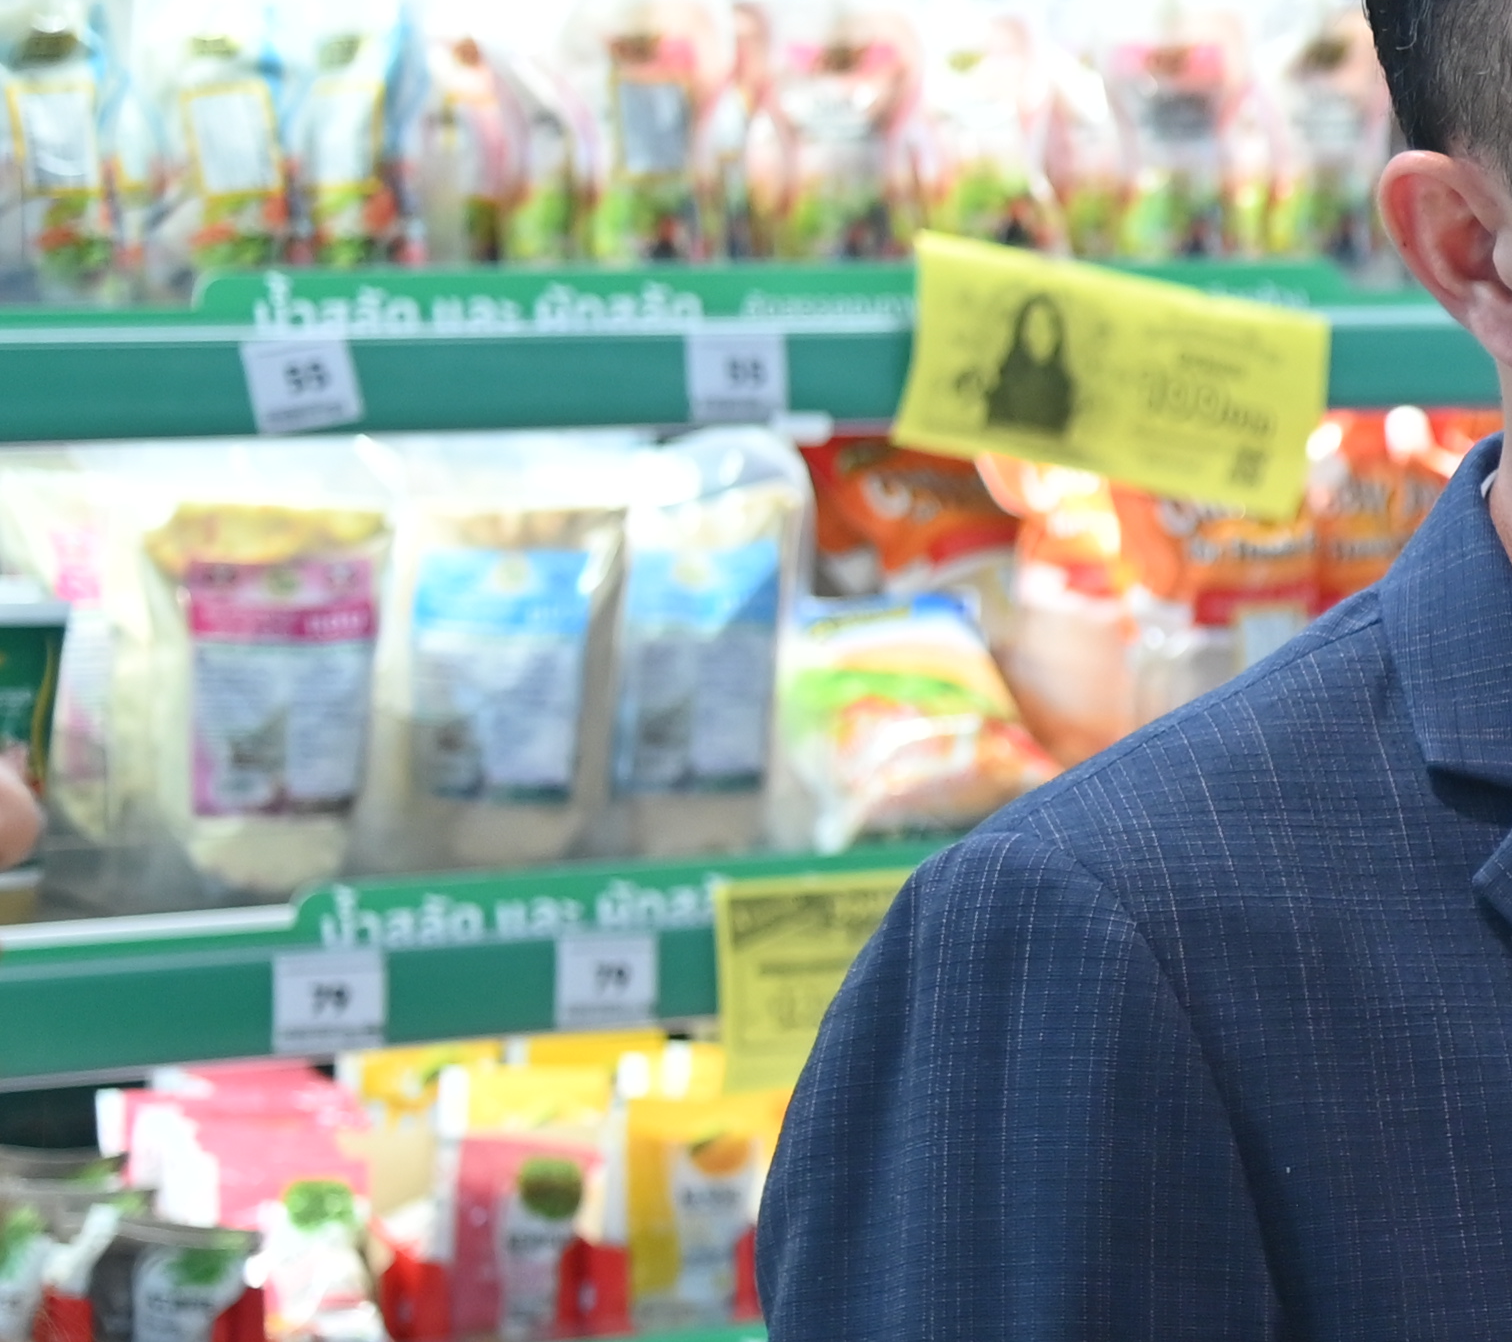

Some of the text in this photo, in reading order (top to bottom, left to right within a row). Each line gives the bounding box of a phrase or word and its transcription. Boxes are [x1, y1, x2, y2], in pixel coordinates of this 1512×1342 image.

[431, 294, 522, 333] และ
[320, 883, 484, 949] น้ำสลัด
[494, 896, 585, 936] และ
